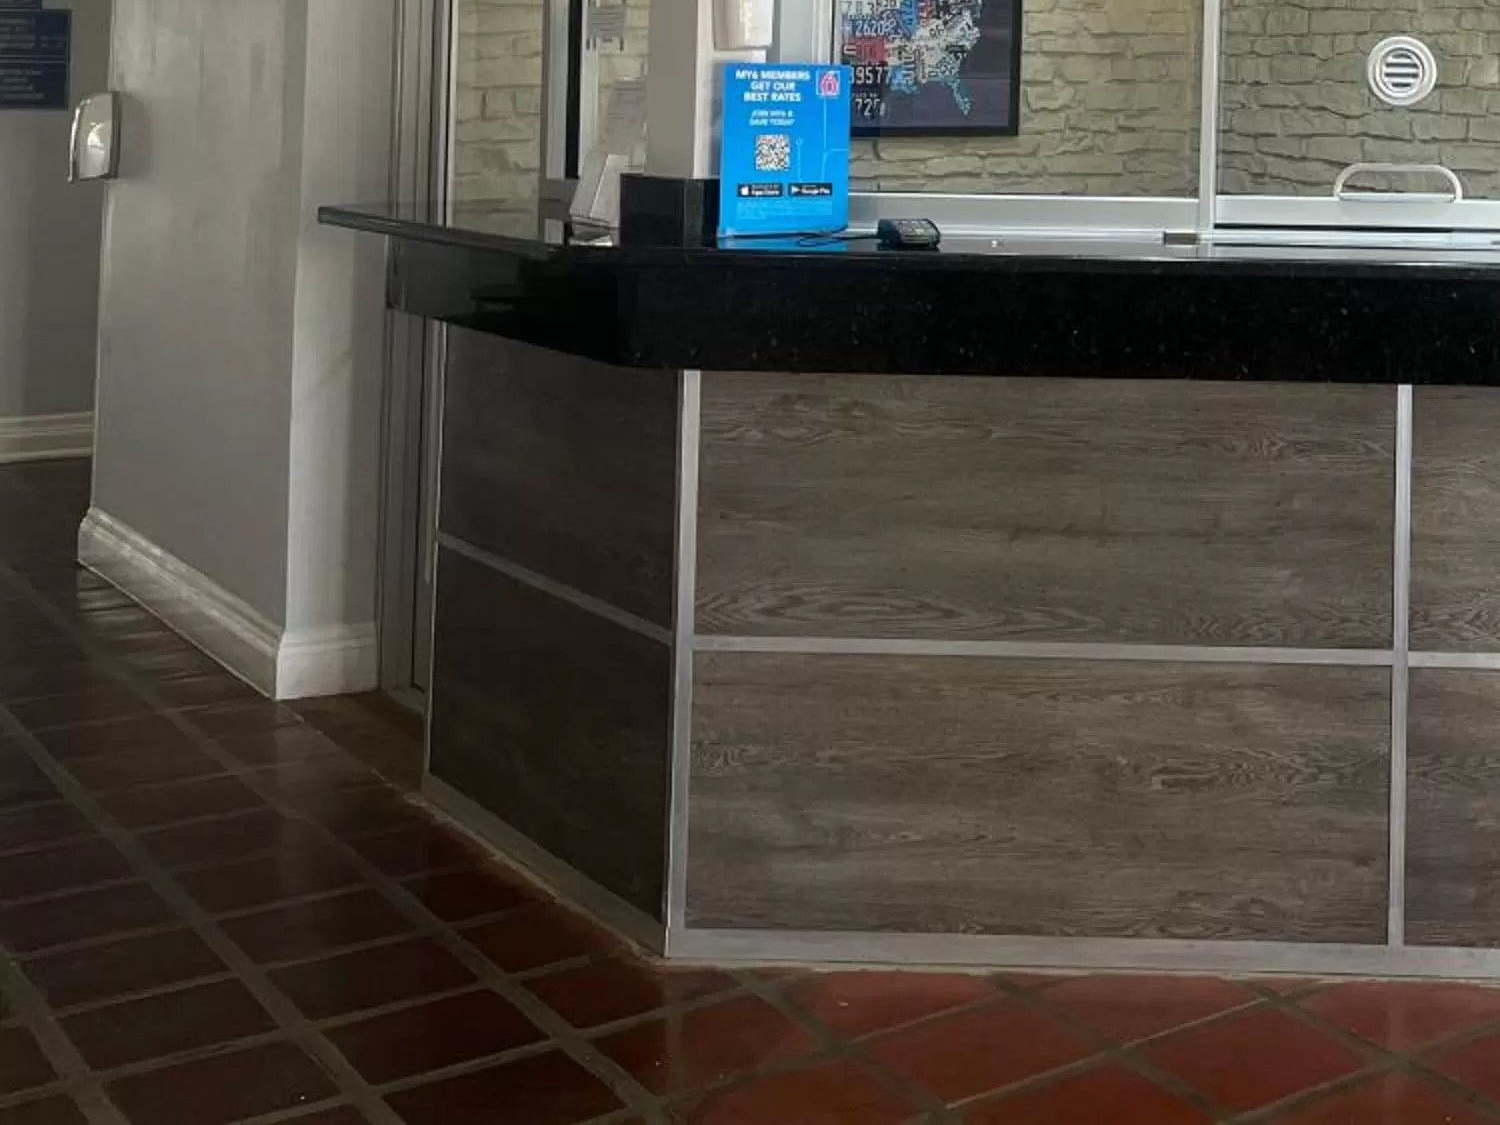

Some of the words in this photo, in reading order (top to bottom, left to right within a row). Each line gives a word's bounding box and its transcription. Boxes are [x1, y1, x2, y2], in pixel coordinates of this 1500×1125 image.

[761, 70, 812, 81] MEMBERS
[750, 81, 771, 91] GET
[773, 81, 796, 92] OUR
[743, 92, 769, 103] BEST
[771, 92, 802, 103] RATES
